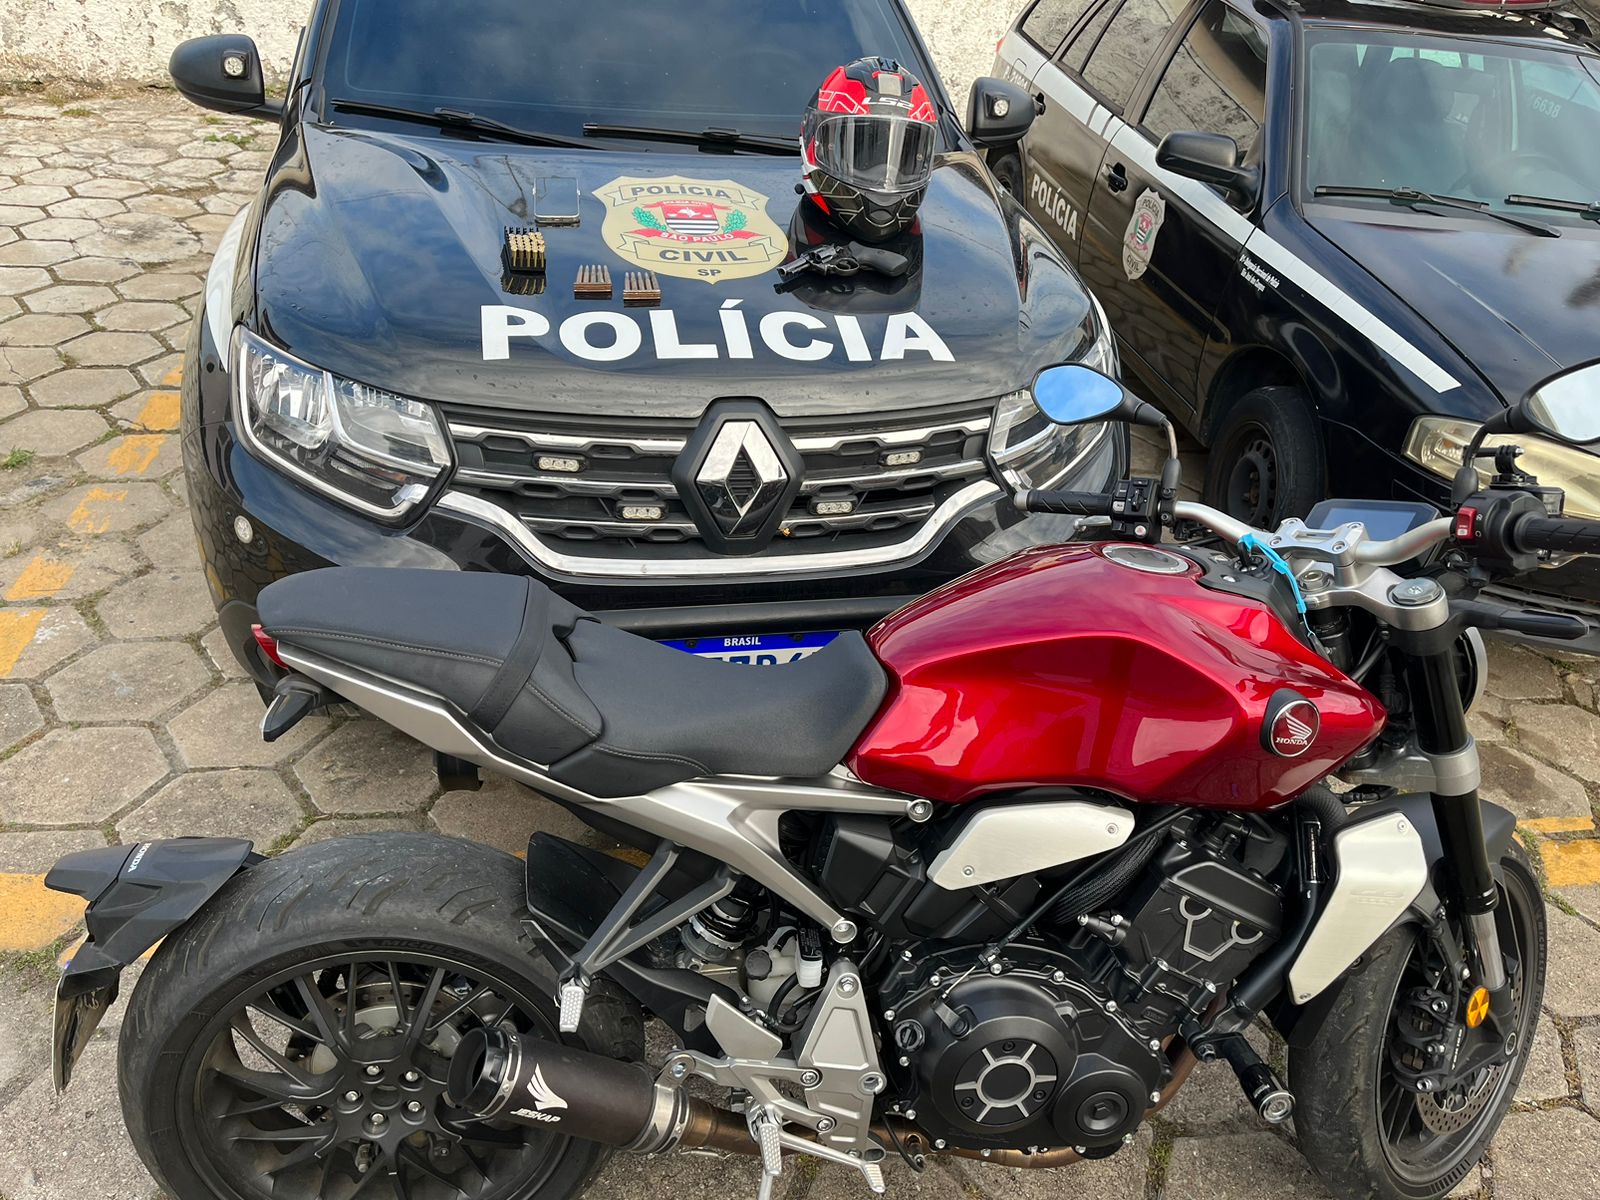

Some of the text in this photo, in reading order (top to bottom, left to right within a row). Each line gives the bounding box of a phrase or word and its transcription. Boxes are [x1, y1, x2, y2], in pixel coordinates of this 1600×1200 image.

[861, 97, 915, 111] LS2
[631, 184, 732, 199] POLÍCIA
[1031, 173, 1078, 241] POLÍCIA
[693, 233, 733, 242] PAULO
[658, 249, 749, 263] CIVIL
[697, 268, 722, 277] SP
[480, 298, 956, 363] POLÍCIA
[723, 636, 762, 647] BRASIL
[1275, 737, 1309, 745] HONDA
[1537, 921, 1547, 982] MICHELIN
[509, 1107, 562, 1123] JESKAP
